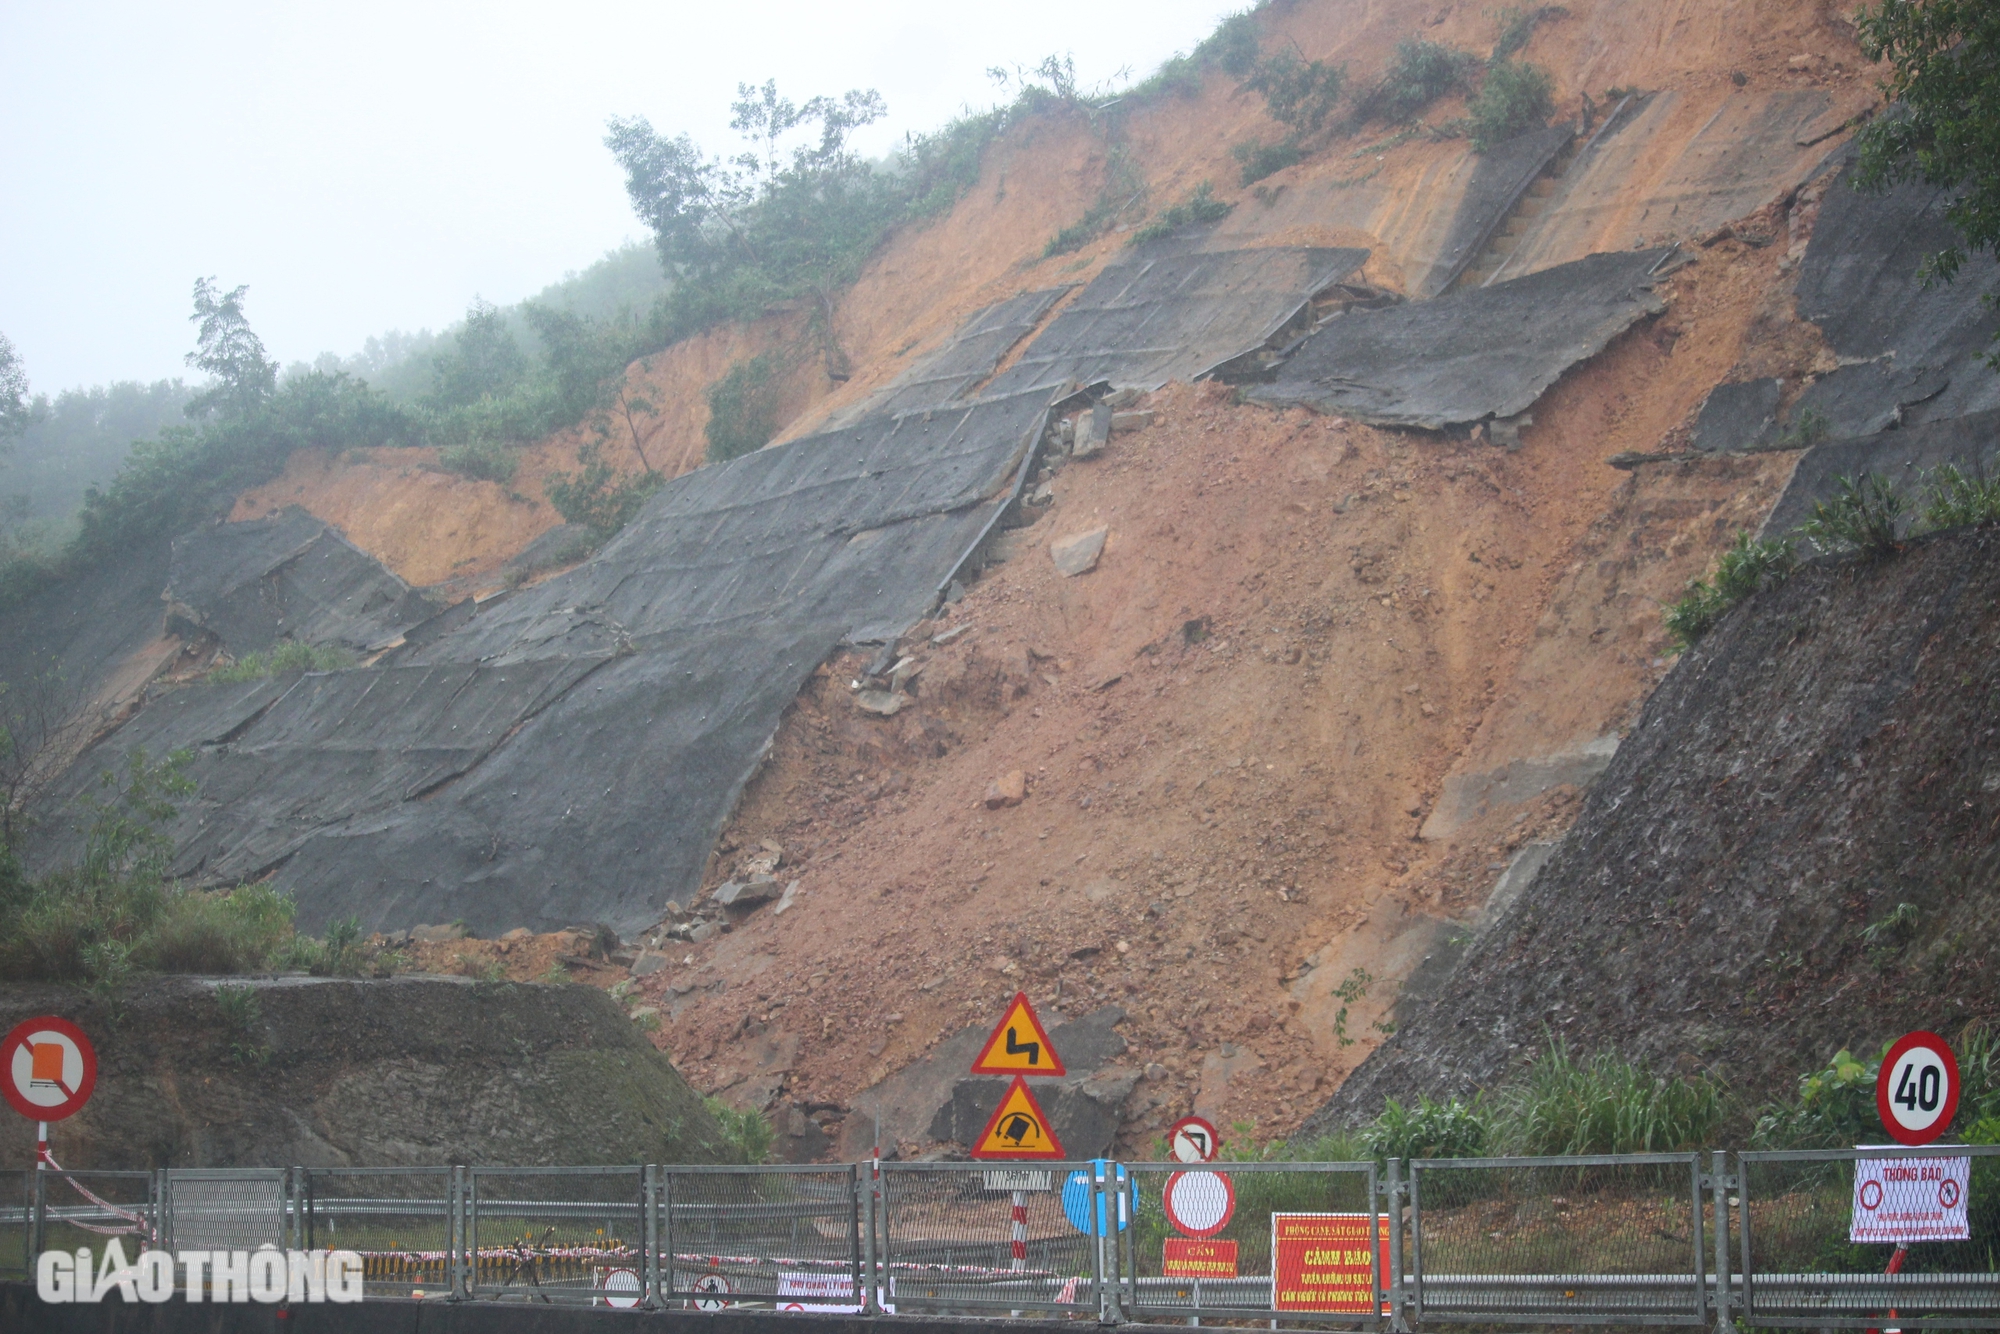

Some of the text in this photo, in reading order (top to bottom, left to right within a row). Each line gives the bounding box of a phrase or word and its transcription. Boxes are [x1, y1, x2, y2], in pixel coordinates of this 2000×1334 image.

[1894, 1063, 1940, 1112] 40
[1883, 1163, 1942, 1181] THÔNG BÁO
